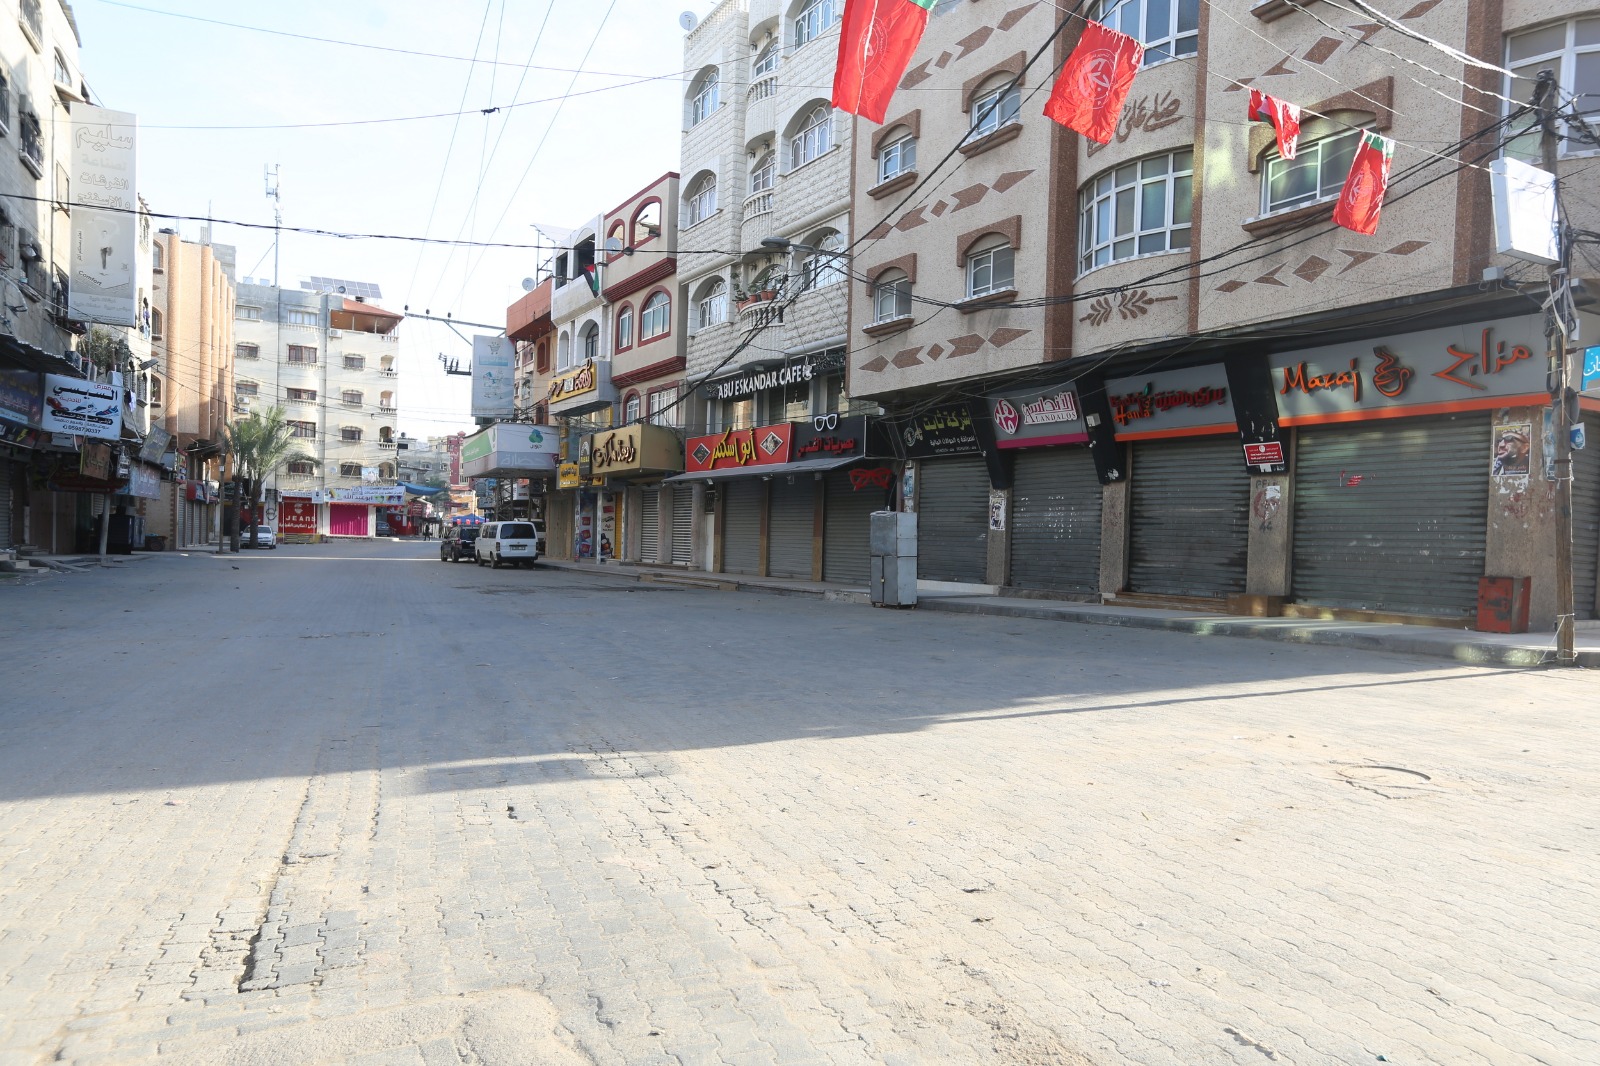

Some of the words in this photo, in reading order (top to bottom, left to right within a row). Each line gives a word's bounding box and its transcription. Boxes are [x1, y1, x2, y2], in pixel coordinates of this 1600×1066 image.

[75, 124, 134, 152] سليم
[78, 270, 103, 286] Comfort
[1431, 327, 1533, 390] مزاج
[718, 380, 734, 400] ABU
[735, 370, 777, 395] ESKANDAR
[779, 364, 802, 385] CAFE
[1280, 357, 1361, 402] Mazaj
[923, 410, 945, 435] ثابت
[947, 408, 971, 430] شركة
[741, 427, 757, 465] أبو
[822, 436, 855, 455] بصريات
